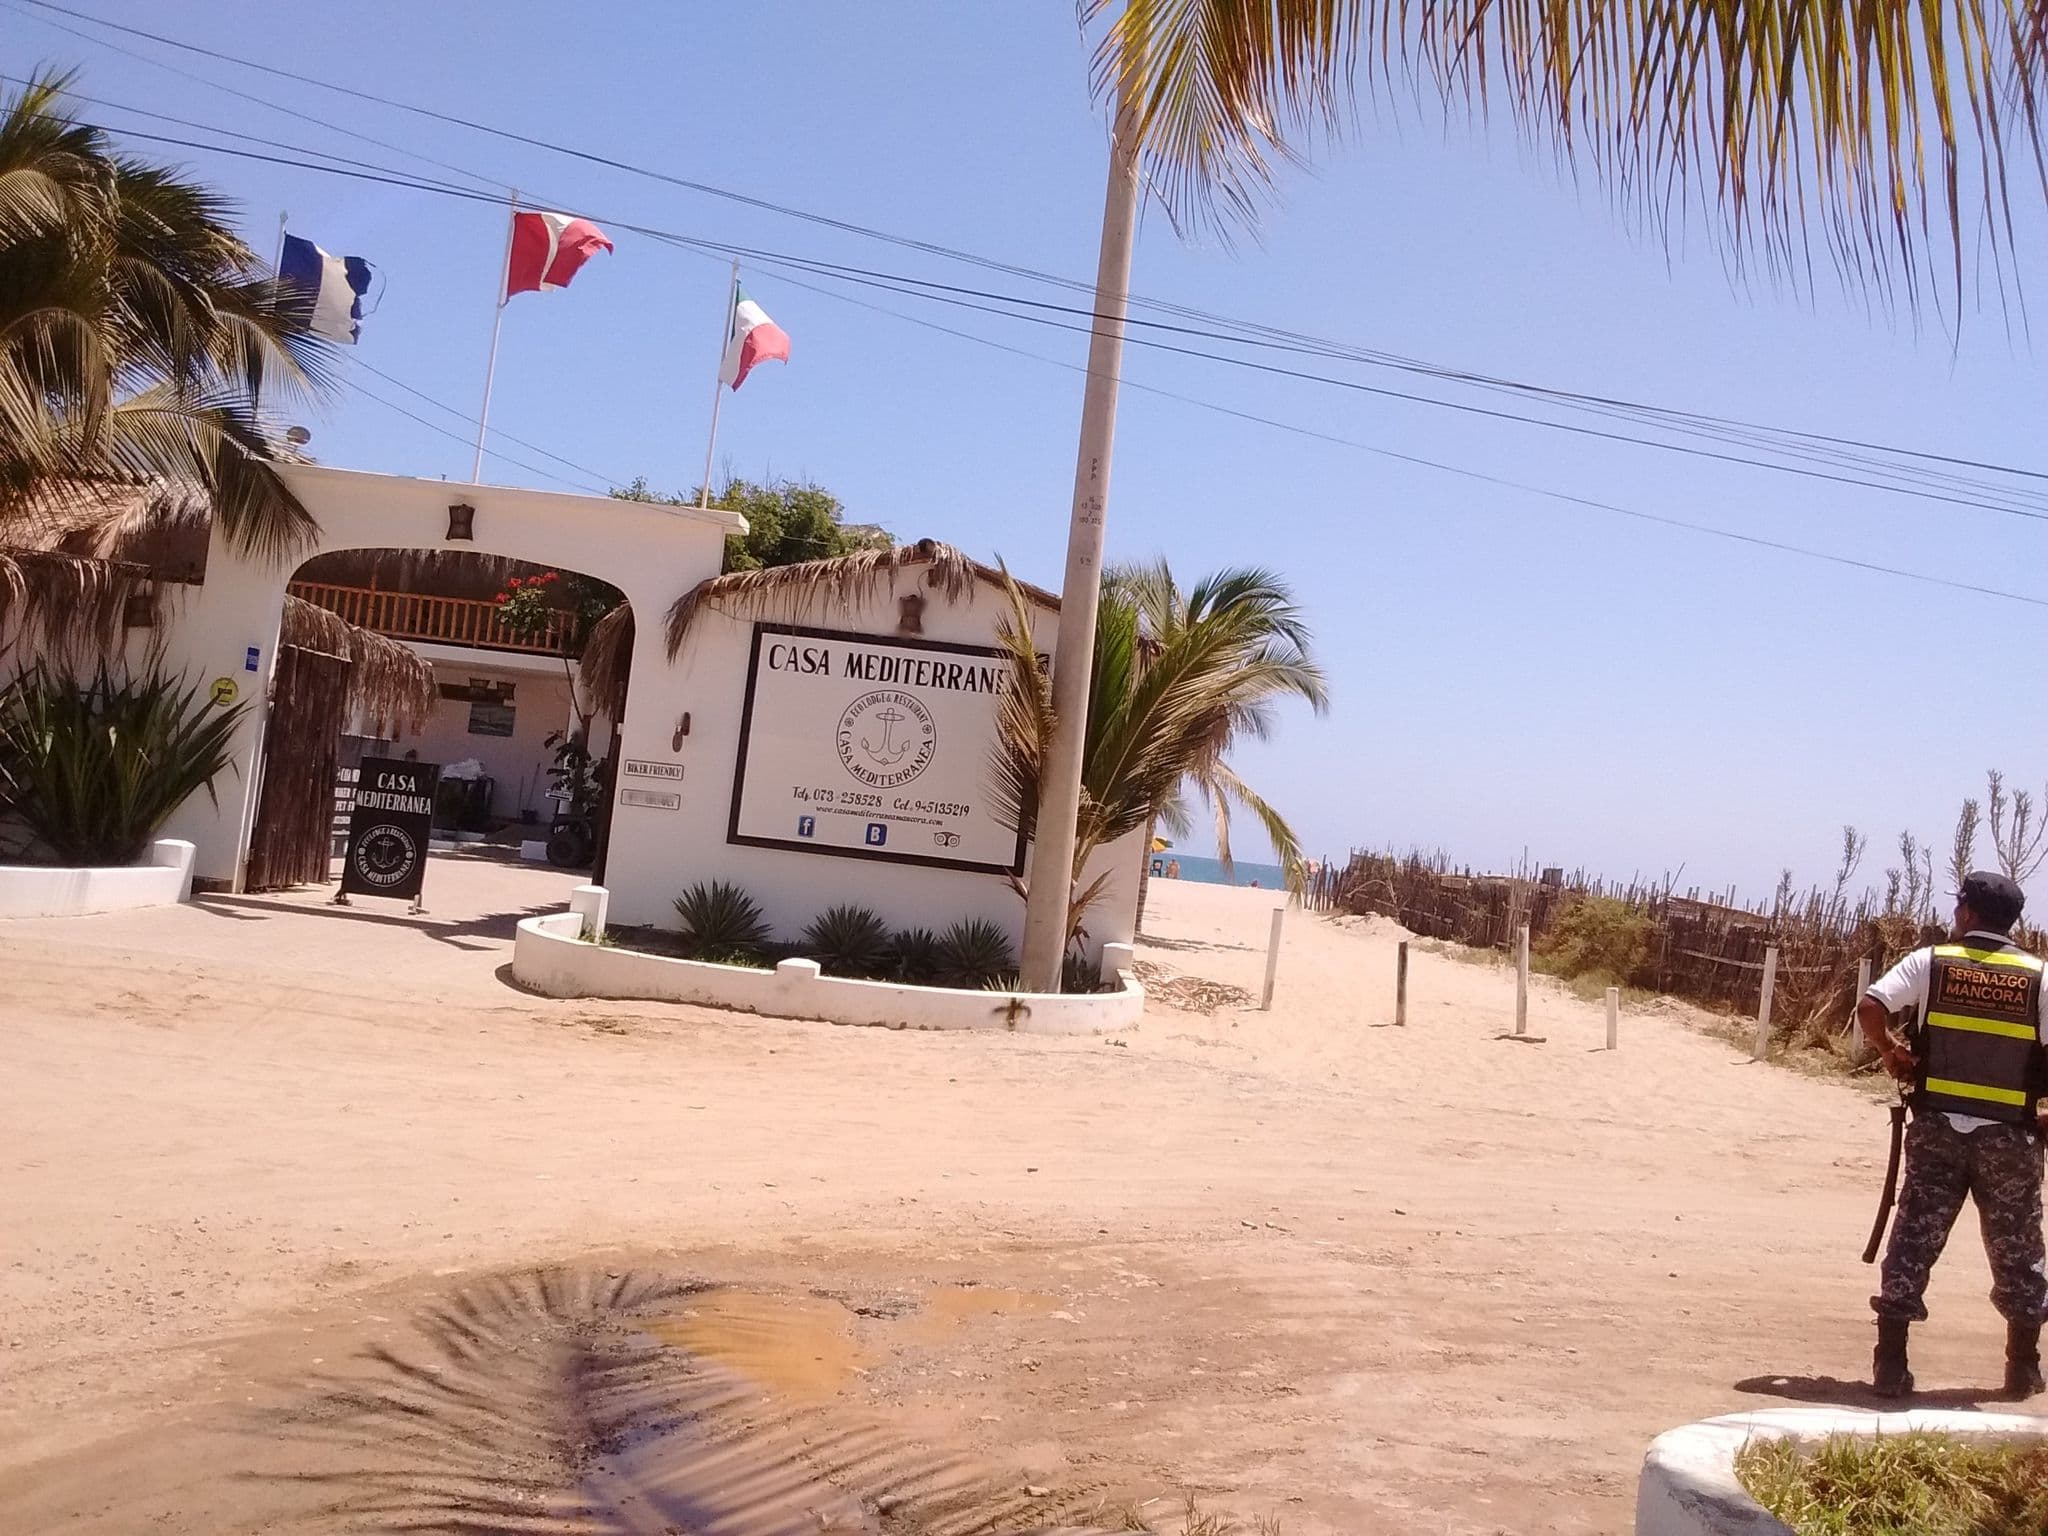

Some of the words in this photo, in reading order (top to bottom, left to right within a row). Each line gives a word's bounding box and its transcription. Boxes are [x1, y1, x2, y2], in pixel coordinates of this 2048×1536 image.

[769, 644, 829, 675] CASA
[843, 652, 1011, 695] MEDITERRAN
[850, 693, 885, 717] ECOLODGE
[840, 731, 853, 764] CASA
[851, 740, 933, 786] MEDITERRANEA
[377, 772, 416, 792] CASA
[627, 763, 648, 774] BIKER
[649, 765, 681, 778] FRIENDLY
[356, 790, 431, 815] MEDITERRANEA
[840, 792, 883, 808] 258528
[1947, 966, 2029, 989] SERENAZGO
[1946, 982, 2025, 1005] MANCORA
